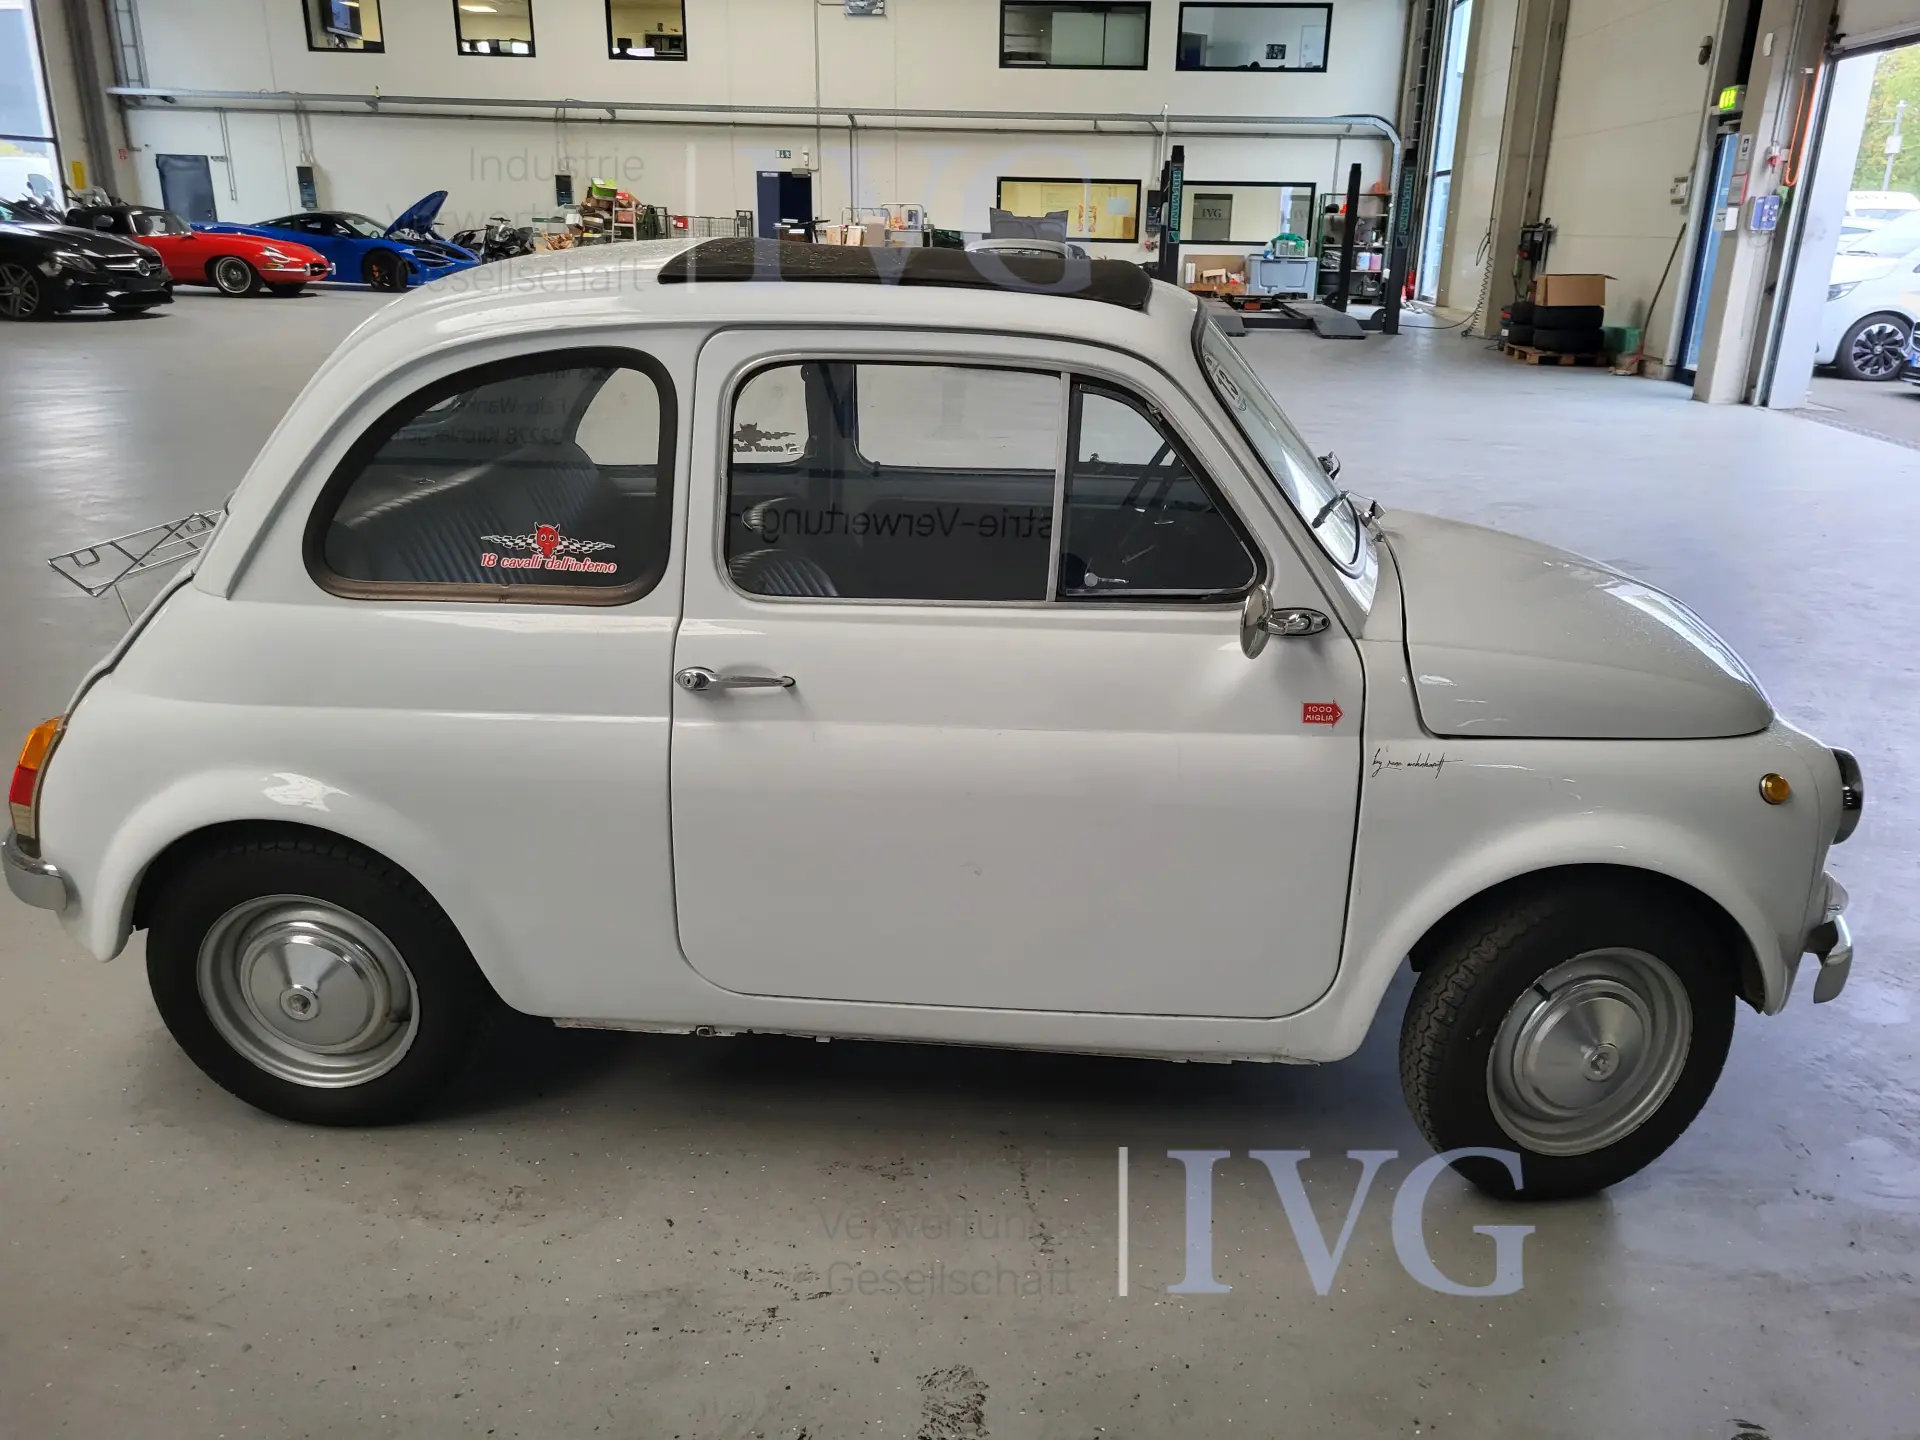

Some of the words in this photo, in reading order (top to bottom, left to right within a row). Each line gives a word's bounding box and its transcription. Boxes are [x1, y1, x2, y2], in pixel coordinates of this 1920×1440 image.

[1201, 208, 1222, 218] IVG
[481, 553, 498, 567] 18
[500, 554, 542, 569] cavalli
[545, 555, 617, 573] dall'inferno
[1305, 714, 1334, 722] MIGLIA
